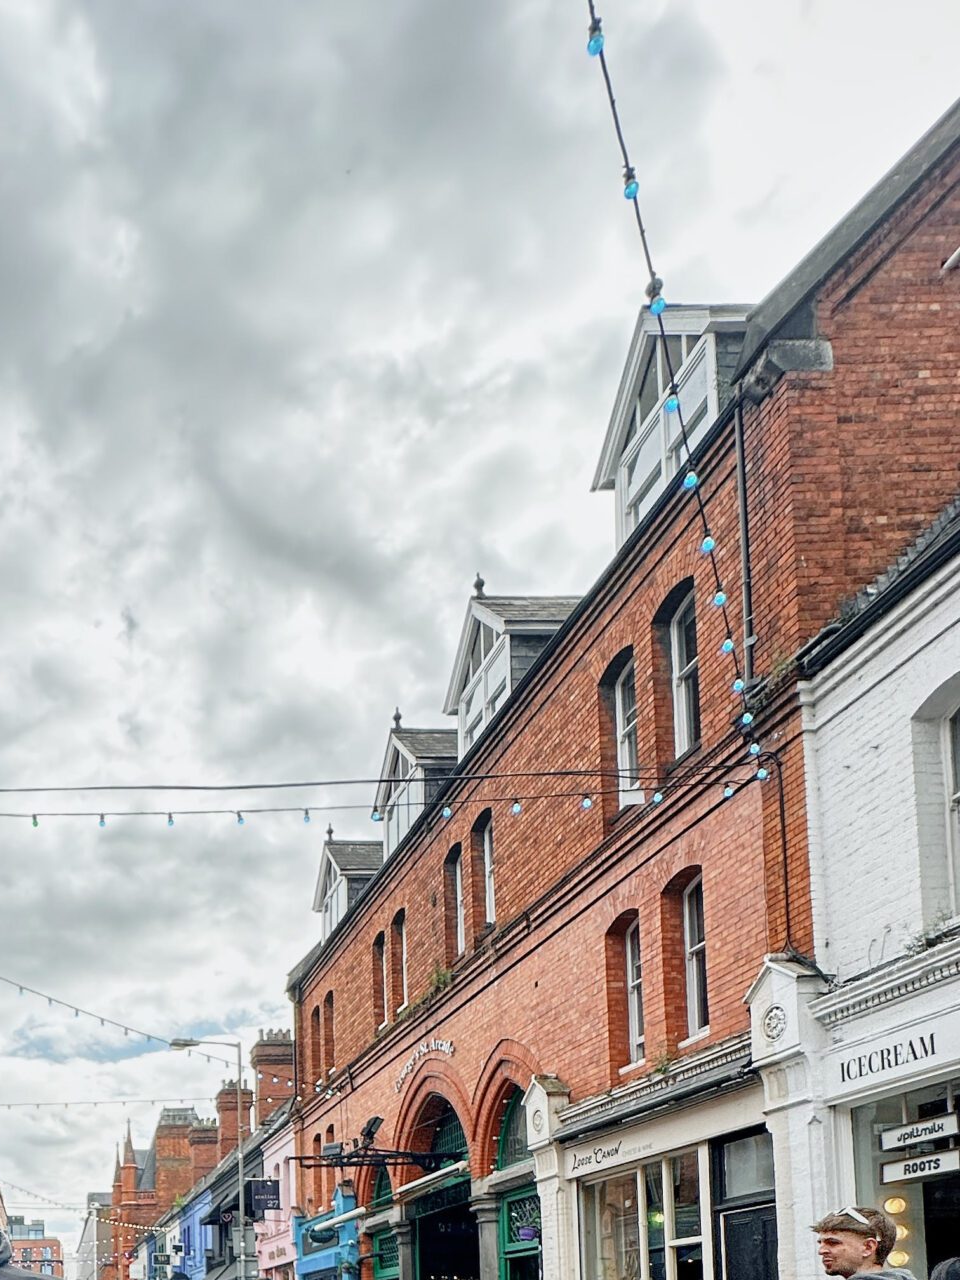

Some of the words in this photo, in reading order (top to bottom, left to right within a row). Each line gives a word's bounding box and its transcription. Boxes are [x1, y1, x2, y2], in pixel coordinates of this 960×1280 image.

[840, 1032, 936, 1083] ICECREAM
[903, 1158, 941, 1176] ROOTS
[266, 1200, 279, 1208] 27
